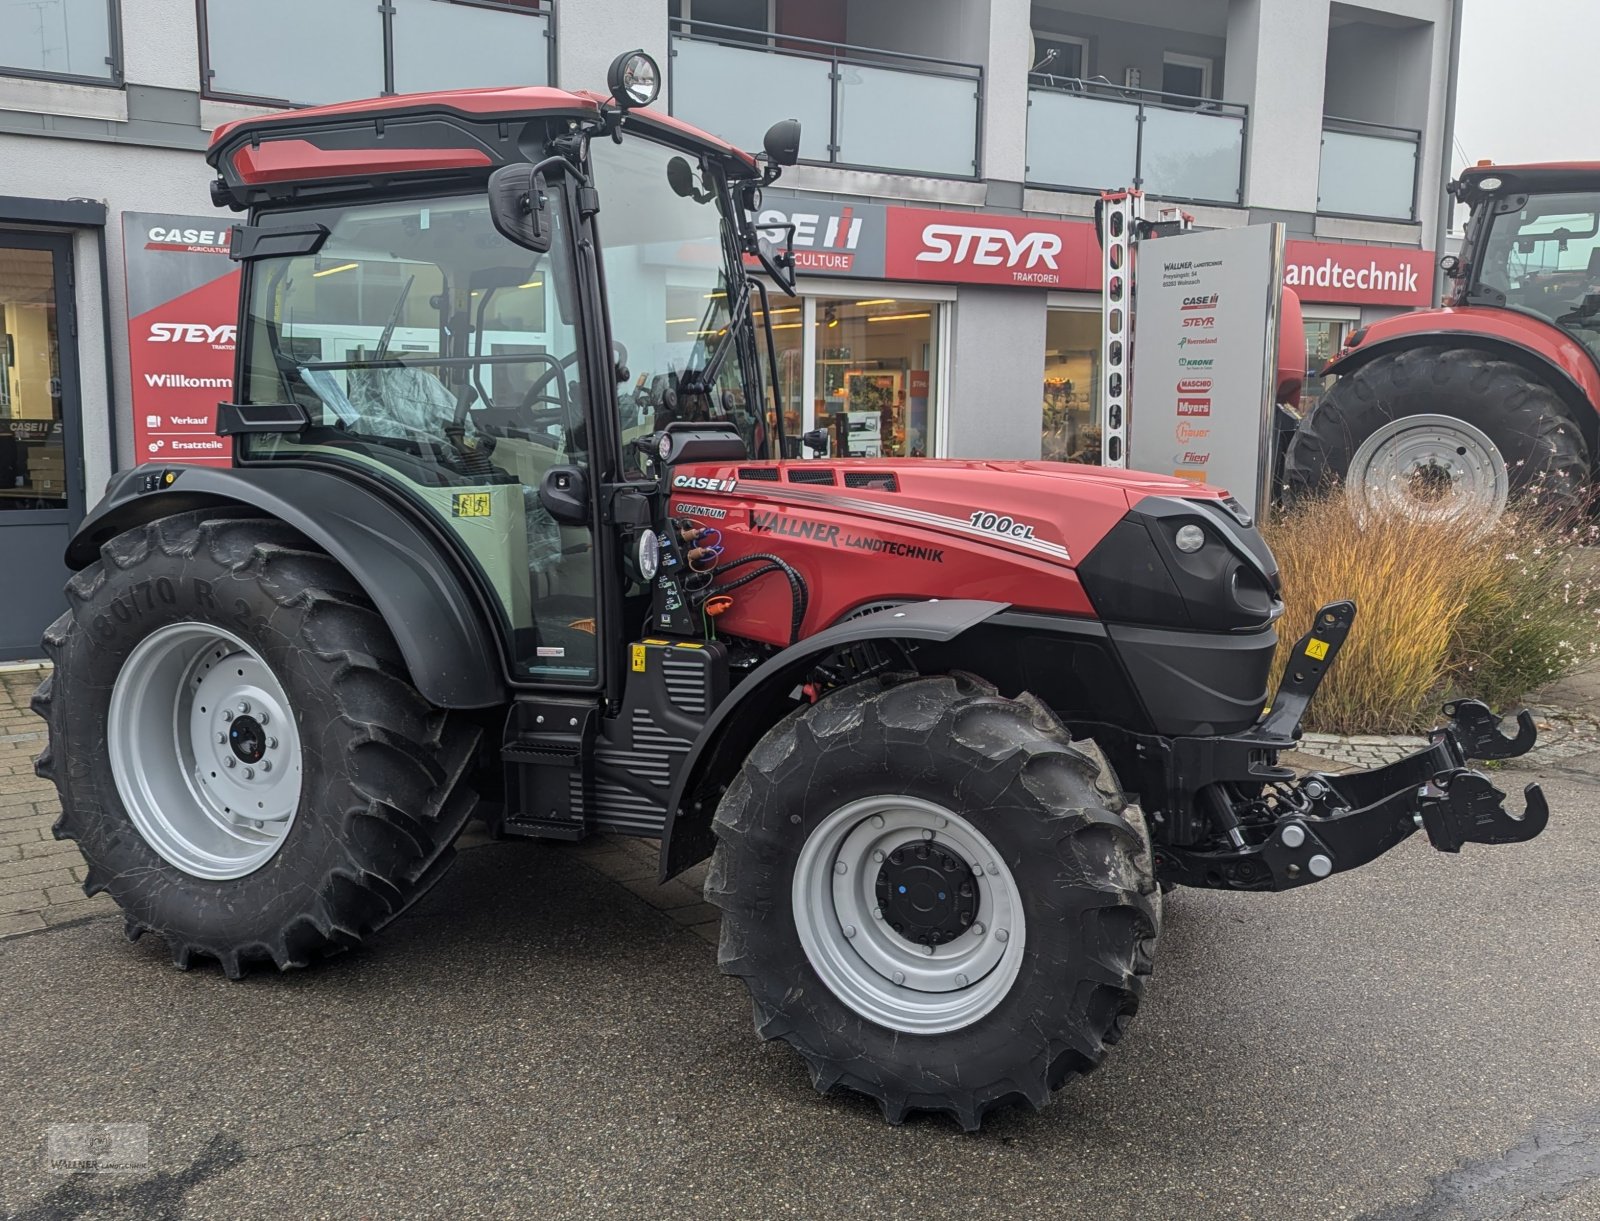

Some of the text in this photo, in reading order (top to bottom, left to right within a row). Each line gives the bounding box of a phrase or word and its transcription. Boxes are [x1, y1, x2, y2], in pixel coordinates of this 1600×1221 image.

[745, 209, 819, 246] SE
[148, 227, 215, 245] CASE
[916, 224, 1062, 270] STEYR
[1012, 271, 1059, 284] TRAKTOREN
[1283, 258, 1419, 292] andtechnik
[1182, 296, 1209, 306] CASE
[1182, 317, 1215, 327] STEYR
[147, 323, 237, 343] STEYR
[144, 373, 233, 388] Willkomm
[1179, 401, 1209, 415] Myers
[10, 422, 38, 432] CASE
[170, 416, 208, 425] Verkauf
[172, 440, 223, 449] Ersatzteile
[1183, 452, 1210, 464] Fliegl
[673, 475, 720, 491] CASE
[676, 503, 727, 519] QUANTUM
